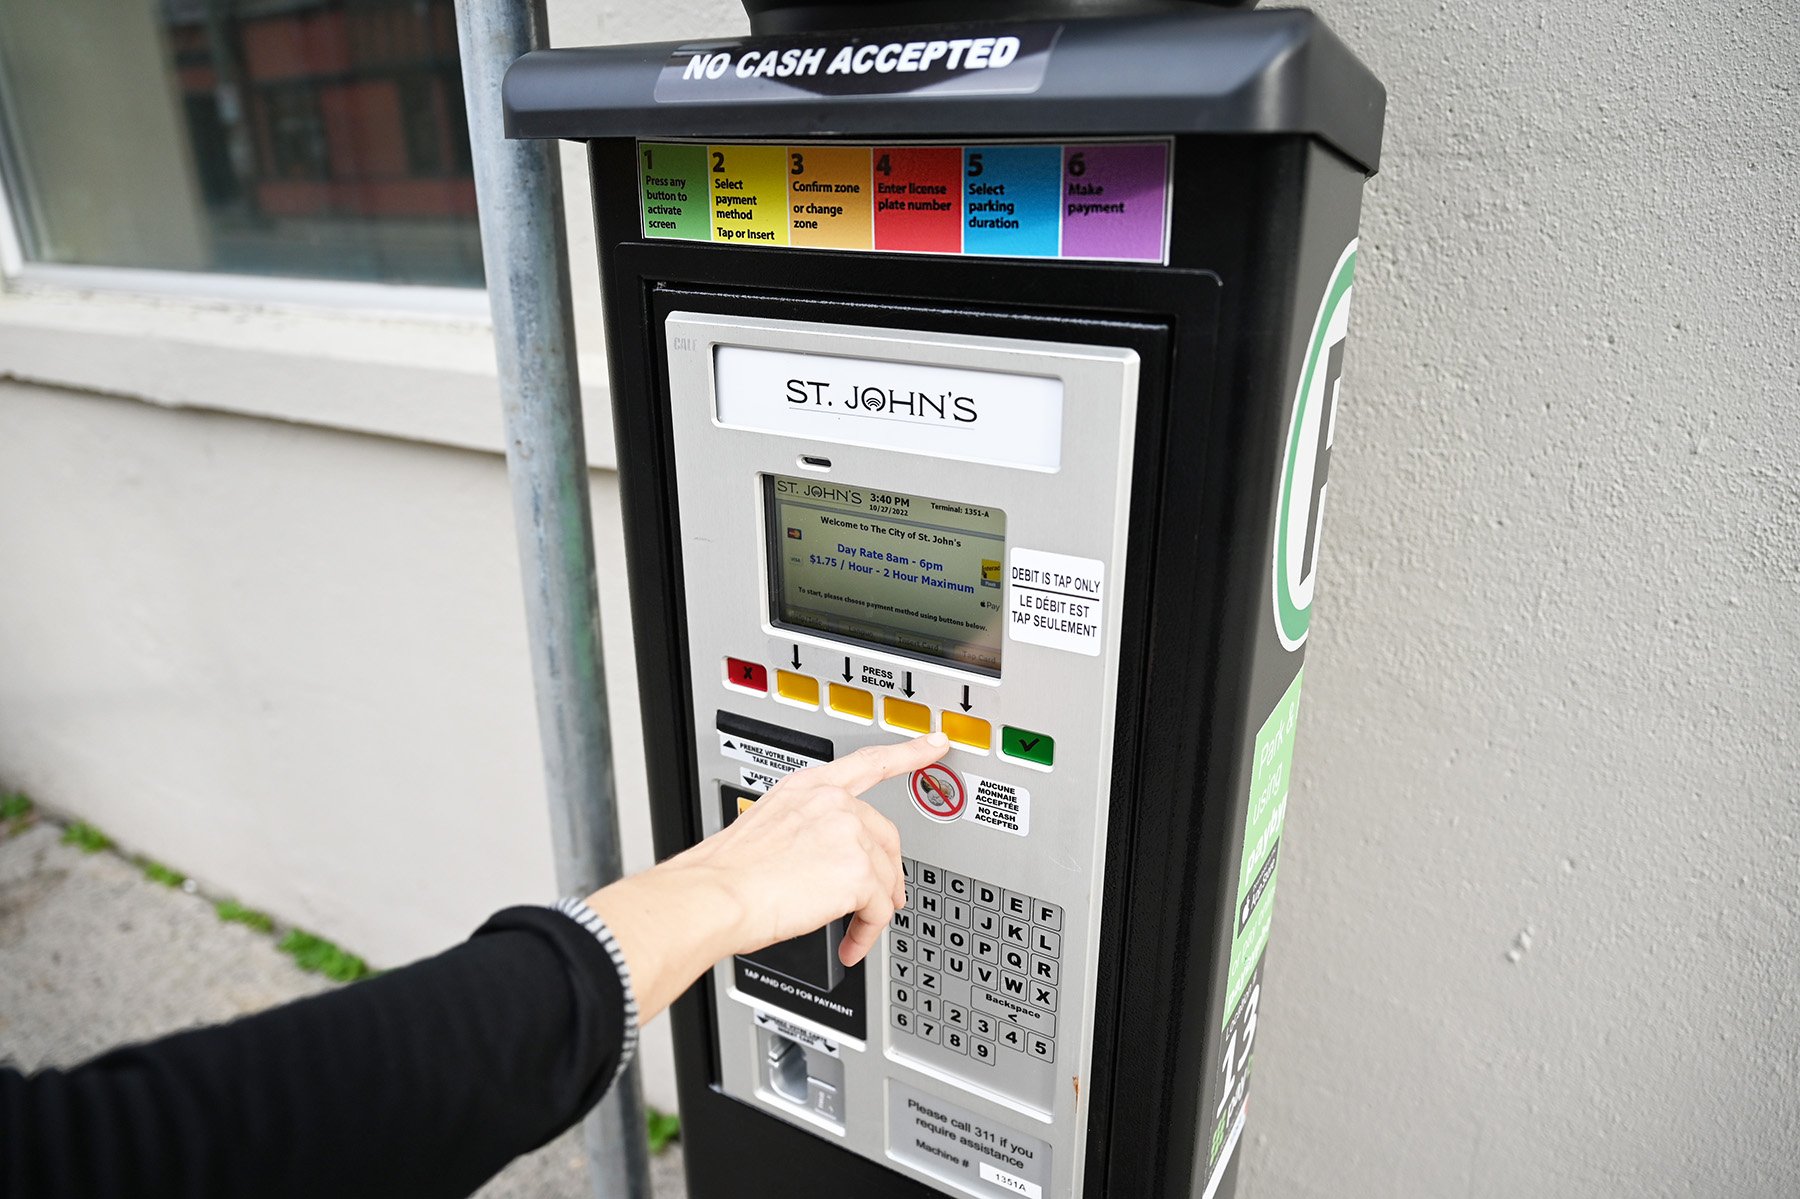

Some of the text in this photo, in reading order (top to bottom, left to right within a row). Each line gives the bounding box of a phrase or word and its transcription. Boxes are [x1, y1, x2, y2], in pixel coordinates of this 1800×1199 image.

[682, 36, 1020, 80] NO CASH ACCEPTED
[643, 150, 653, 170] 1
[712, 152, 726, 173] 2
[791, 153, 804, 174] 3
[876, 154, 892, 176] 4
[967, 153, 983, 177] 5
[1068, 153, 1086, 177] 6
[646, 175, 686, 189] Press any
[714, 178, 744, 190] Select
[792, 180, 860, 194] Confirm zone
[877, 183, 947, 195] Enter license
[968, 183, 1005, 196] Select
[1067, 183, 1104, 196] Make
[646, 190, 688, 202] button to
[715, 196, 757, 207] payment
[647, 204, 682, 216] activate
[716, 209, 753, 220] method
[793, 203, 843, 218] or change
[877, 199, 952, 212] plate number
[968, 200, 1015, 215] parking
[1067, 202, 1125, 215] payment
[648, 219, 677, 229] screen
[793, 219, 818, 229] zone
[968, 216, 1019, 230] duration
[717, 227, 775, 241] Tap or Insert
[786, 379, 979, 423] ST. JOHN'S
[777, 480, 863, 505] ST. JOHN'S
[870, 493, 910, 508] 3:40 PM
[869, 504, 909, 517] 10/27/2022
[930, 502, 990, 518] Terminal: 1351-A
[820, 516, 962, 548] Welcome to The City of St. John's
[837, 543, 943, 572] Day Rate 8am 6pm
[809, 554, 837, 568] $1.75
[848, 561, 873, 575] Hour
[883, 568, 890, 578] 2
[892, 569, 918, 583] Hour
[921, 575, 975, 594] Maximum
[1012, 566, 1039, 583] DEBIT
[1042, 572, 1051, 585] IS
[1054, 574, 1072, 588] TAP
[1074, 577, 1101, 593] ONLY
[798, 586, 988, 632] To start, please choose payment method using buttons below.
[987, 601, 1000, 612] Pay
[1020, 594, 1090, 618] LE DÉBIT EST
[1012, 610, 1097, 638] TAP SEULEMENT
[862, 665, 894, 680] PRESS
[861, 675, 895, 690] BELOW
[739, 742, 808, 768] PRENEZ VOTRE BILLET
[752, 756, 796, 773] TAKE RECEIPT
[749, 771, 774, 784] TAPEZ
[977, 787, 1018, 804] MONNAIE
[980, 780, 1016, 795] AUCUNE
[1253, 762, 1283, 826] using
[975, 794, 1020, 812] ACCEPTÉE
[975, 813, 1019, 831] ACCEPTED
[978, 806, 1016, 823] NO CASH
[923, 870, 1054, 921] B C D E F
[923, 896, 1052, 951] H I J K L
[894, 913, 1052, 978] M N O P Q R
[896, 939, 1051, 1005] S T U V W X
[896, 963, 935, 989] Y Z
[744, 968, 854, 1017] TAP AND GO FOR PAYMENT
[985, 993, 1041, 1020] Backspace
[897, 988, 1047, 1056] 0 1 2 3 4 5
[897, 1013, 988, 1058] 6 7 8 9
[907, 1098, 1034, 1160] Please call 311 if you
[915, 1117, 1025, 1169] require assistance
[915, 1138, 1027, 1192] Machine # 1351A
